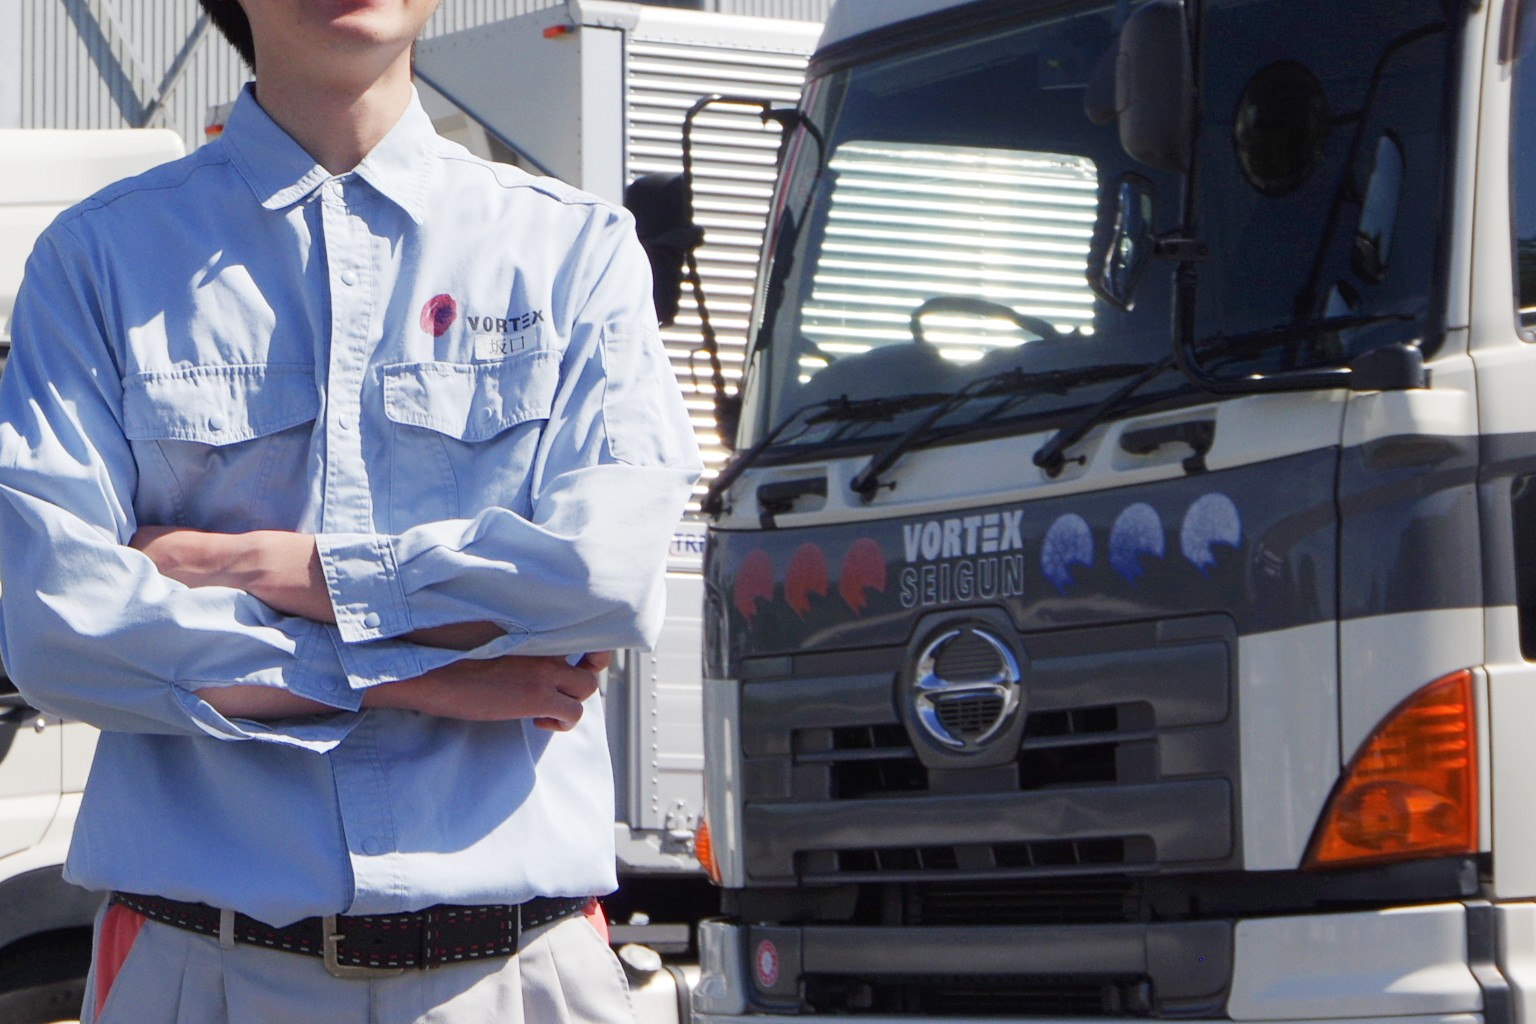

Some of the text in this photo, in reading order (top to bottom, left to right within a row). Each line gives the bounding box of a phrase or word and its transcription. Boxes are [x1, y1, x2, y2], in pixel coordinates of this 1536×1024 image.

[467, 309, 544, 333] VORTEX
[489, 336, 524, 355] 坂口
[903, 510, 1024, 563] VORTEX
[900, 554, 1024, 608] SEIGUN
